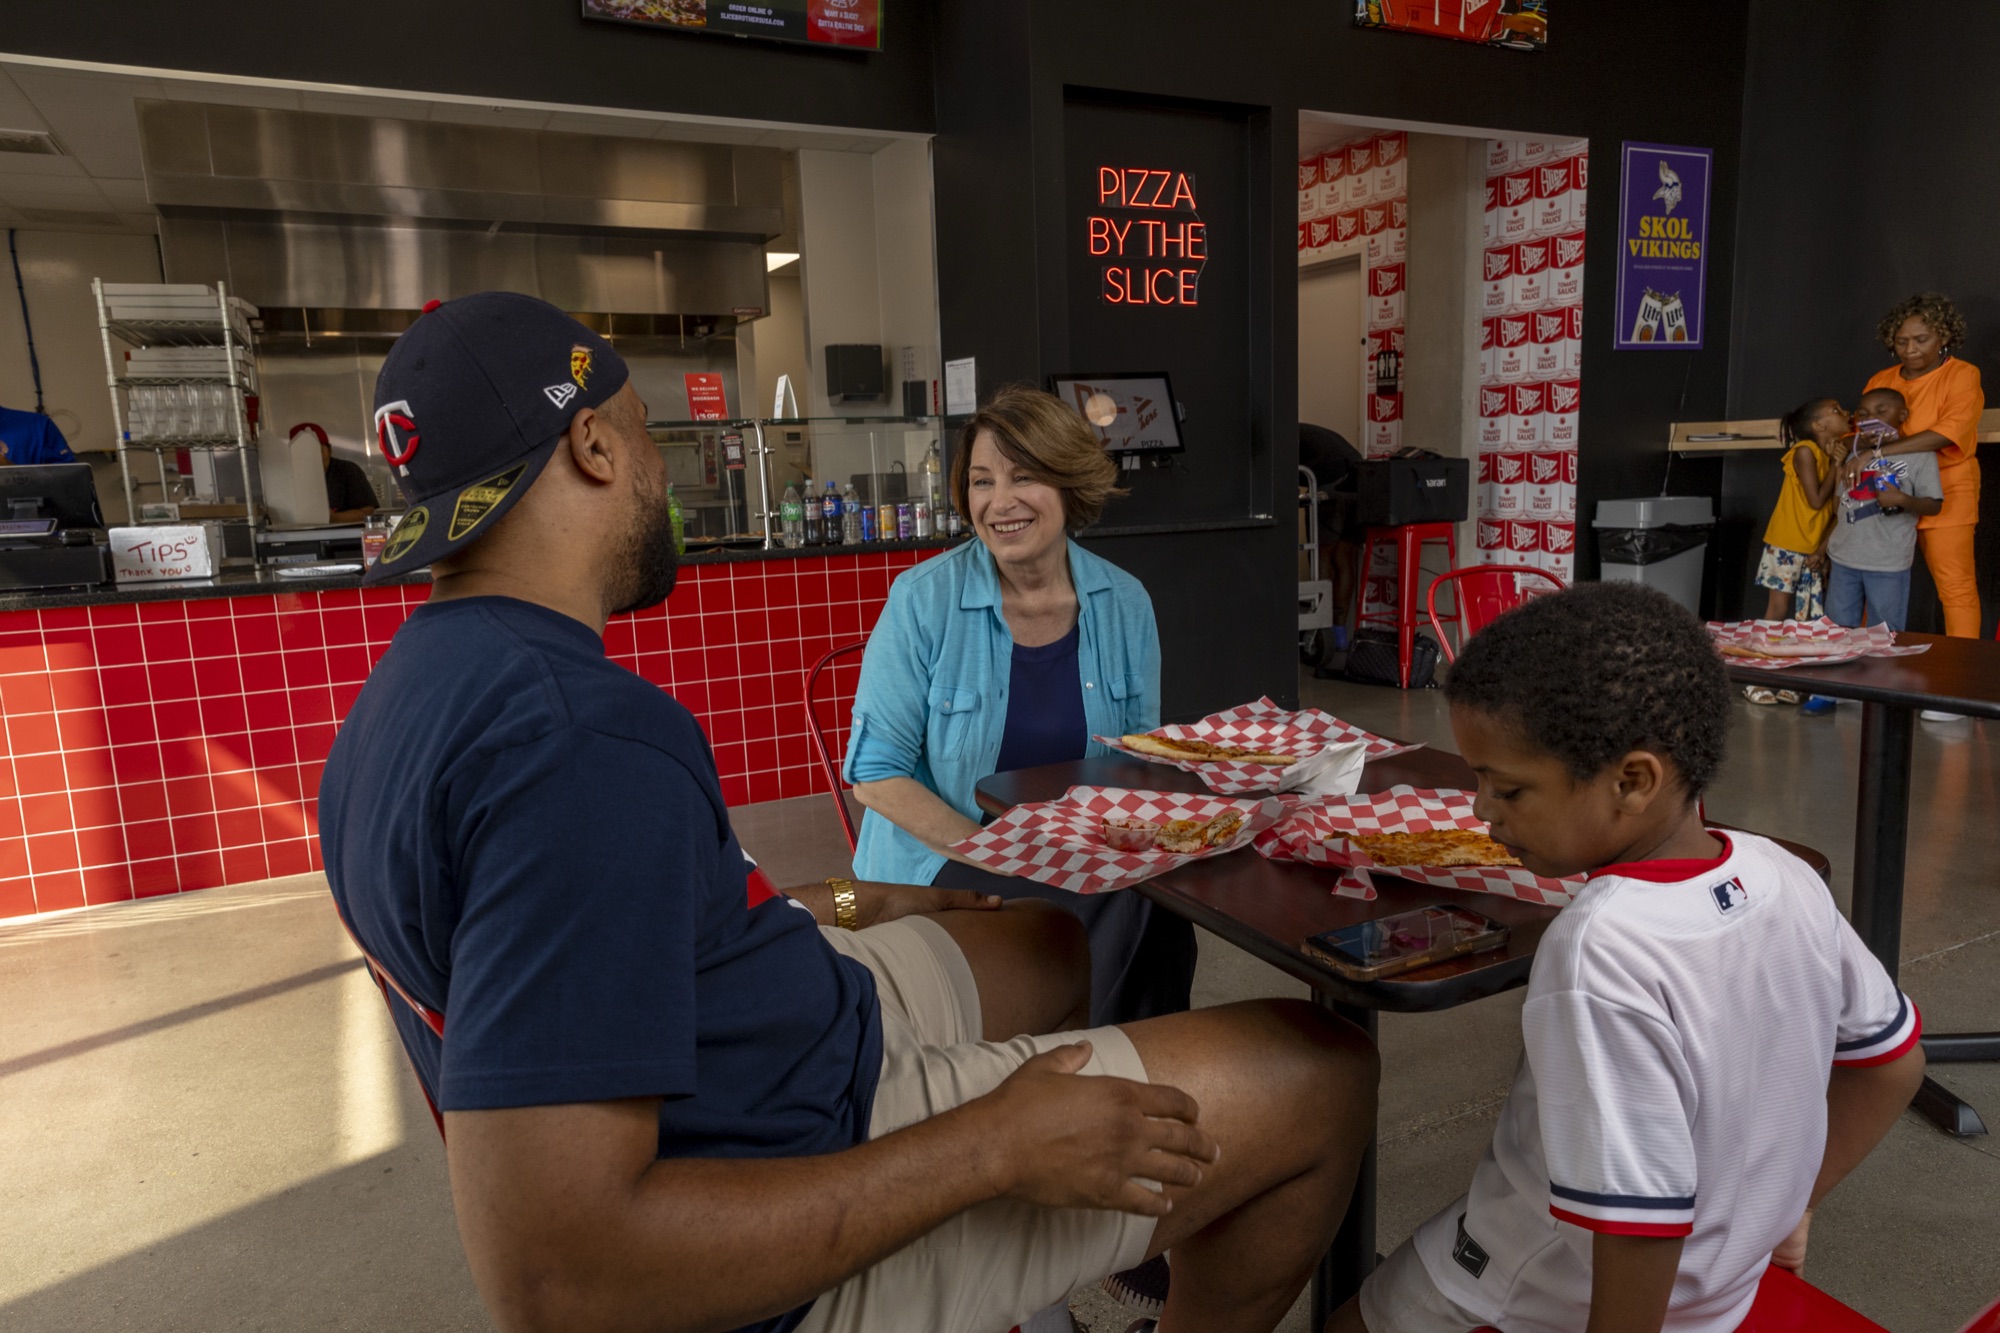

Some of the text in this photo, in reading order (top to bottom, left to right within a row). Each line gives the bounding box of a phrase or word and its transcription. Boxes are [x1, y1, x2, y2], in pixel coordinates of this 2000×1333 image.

[728, 4, 746, 12] ORDER
[748, 6, 766, 14] ONLINE
[720, 12, 784, 26] SLICEBROTHERSUSA.COM
[1526, 145, 1544, 156] SAUCE
[1491, 155, 1508, 165] SAUCE
[1100, 167, 1196, 210] PIZZA
[1542, 209, 1562, 218] TOMATO
[1506, 217, 1525, 225] TOMATO
[1542, 215, 1561, 225] SAUCE
[1506, 223, 1524, 233] SAUCE
[1639, 216, 1692, 239] SKOL
[1090, 217, 1206, 260] BY THE
[1628, 239, 1700, 259] VIKINGS
[1105, 267, 1198, 305] SLICE
[1522, 286, 1540, 294] TOMATO
[1558, 285, 1577, 295] SAUCE
[1522, 292, 1540, 300] SAUCE
[1487, 297, 1504, 306] SAUCE
[1642, 302, 1660, 322] Lite
[1502, 365, 1520, 373] SAUCE
[1537, 360, 1556, 369] SAUCE
[1553, 431, 1572, 439] SAUCE
[1141, 440, 1165, 448] PIZZA
[120, 568, 153, 577] Thank
